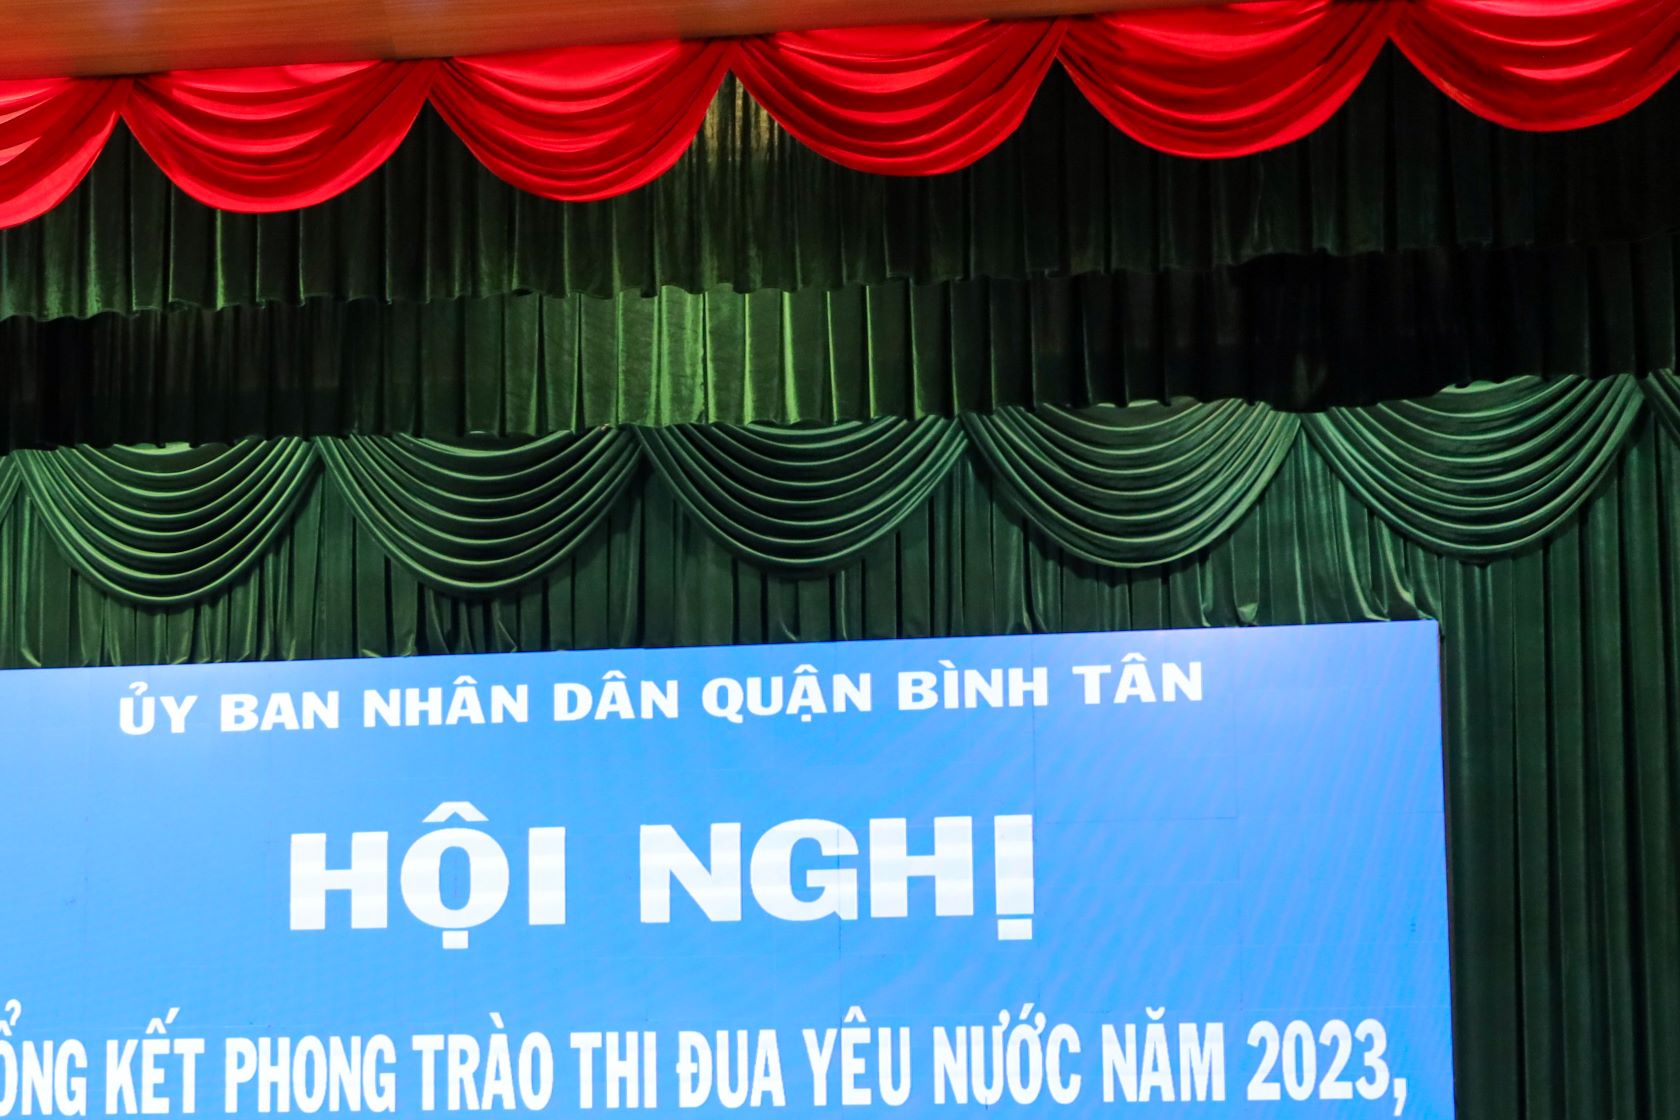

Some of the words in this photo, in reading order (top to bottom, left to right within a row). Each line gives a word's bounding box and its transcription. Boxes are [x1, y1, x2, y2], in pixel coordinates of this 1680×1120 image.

[119, 679, 200, 737] ỦY
[219, 690, 340, 734] BAN
[363, 673, 528, 729] NHÂN
[553, 669, 680, 724] DÂN
[702, 664, 872, 723] QUẬN
[898, 656, 1049, 713] BÌNH
[1071, 650, 1203, 707] TÂN
[289, 801, 566, 949] HỘI
[639, 815, 1035, 940] NGHỊ
[105, 1007, 205, 1115] KẾT
[224, 1034, 397, 1114] PHONG
[411, 1011, 554, 1112] TRÀO
[570, 1031, 658, 1109] THI
[674, 1030, 786, 1109] ĐUA
[802, 1005, 911, 1107] YÊU
[933, 1002, 1083, 1106] NƯỚC
[1101, 1006, 1227, 1104] NĂM
[1247, 1018, 1408, 1116] 2023,
